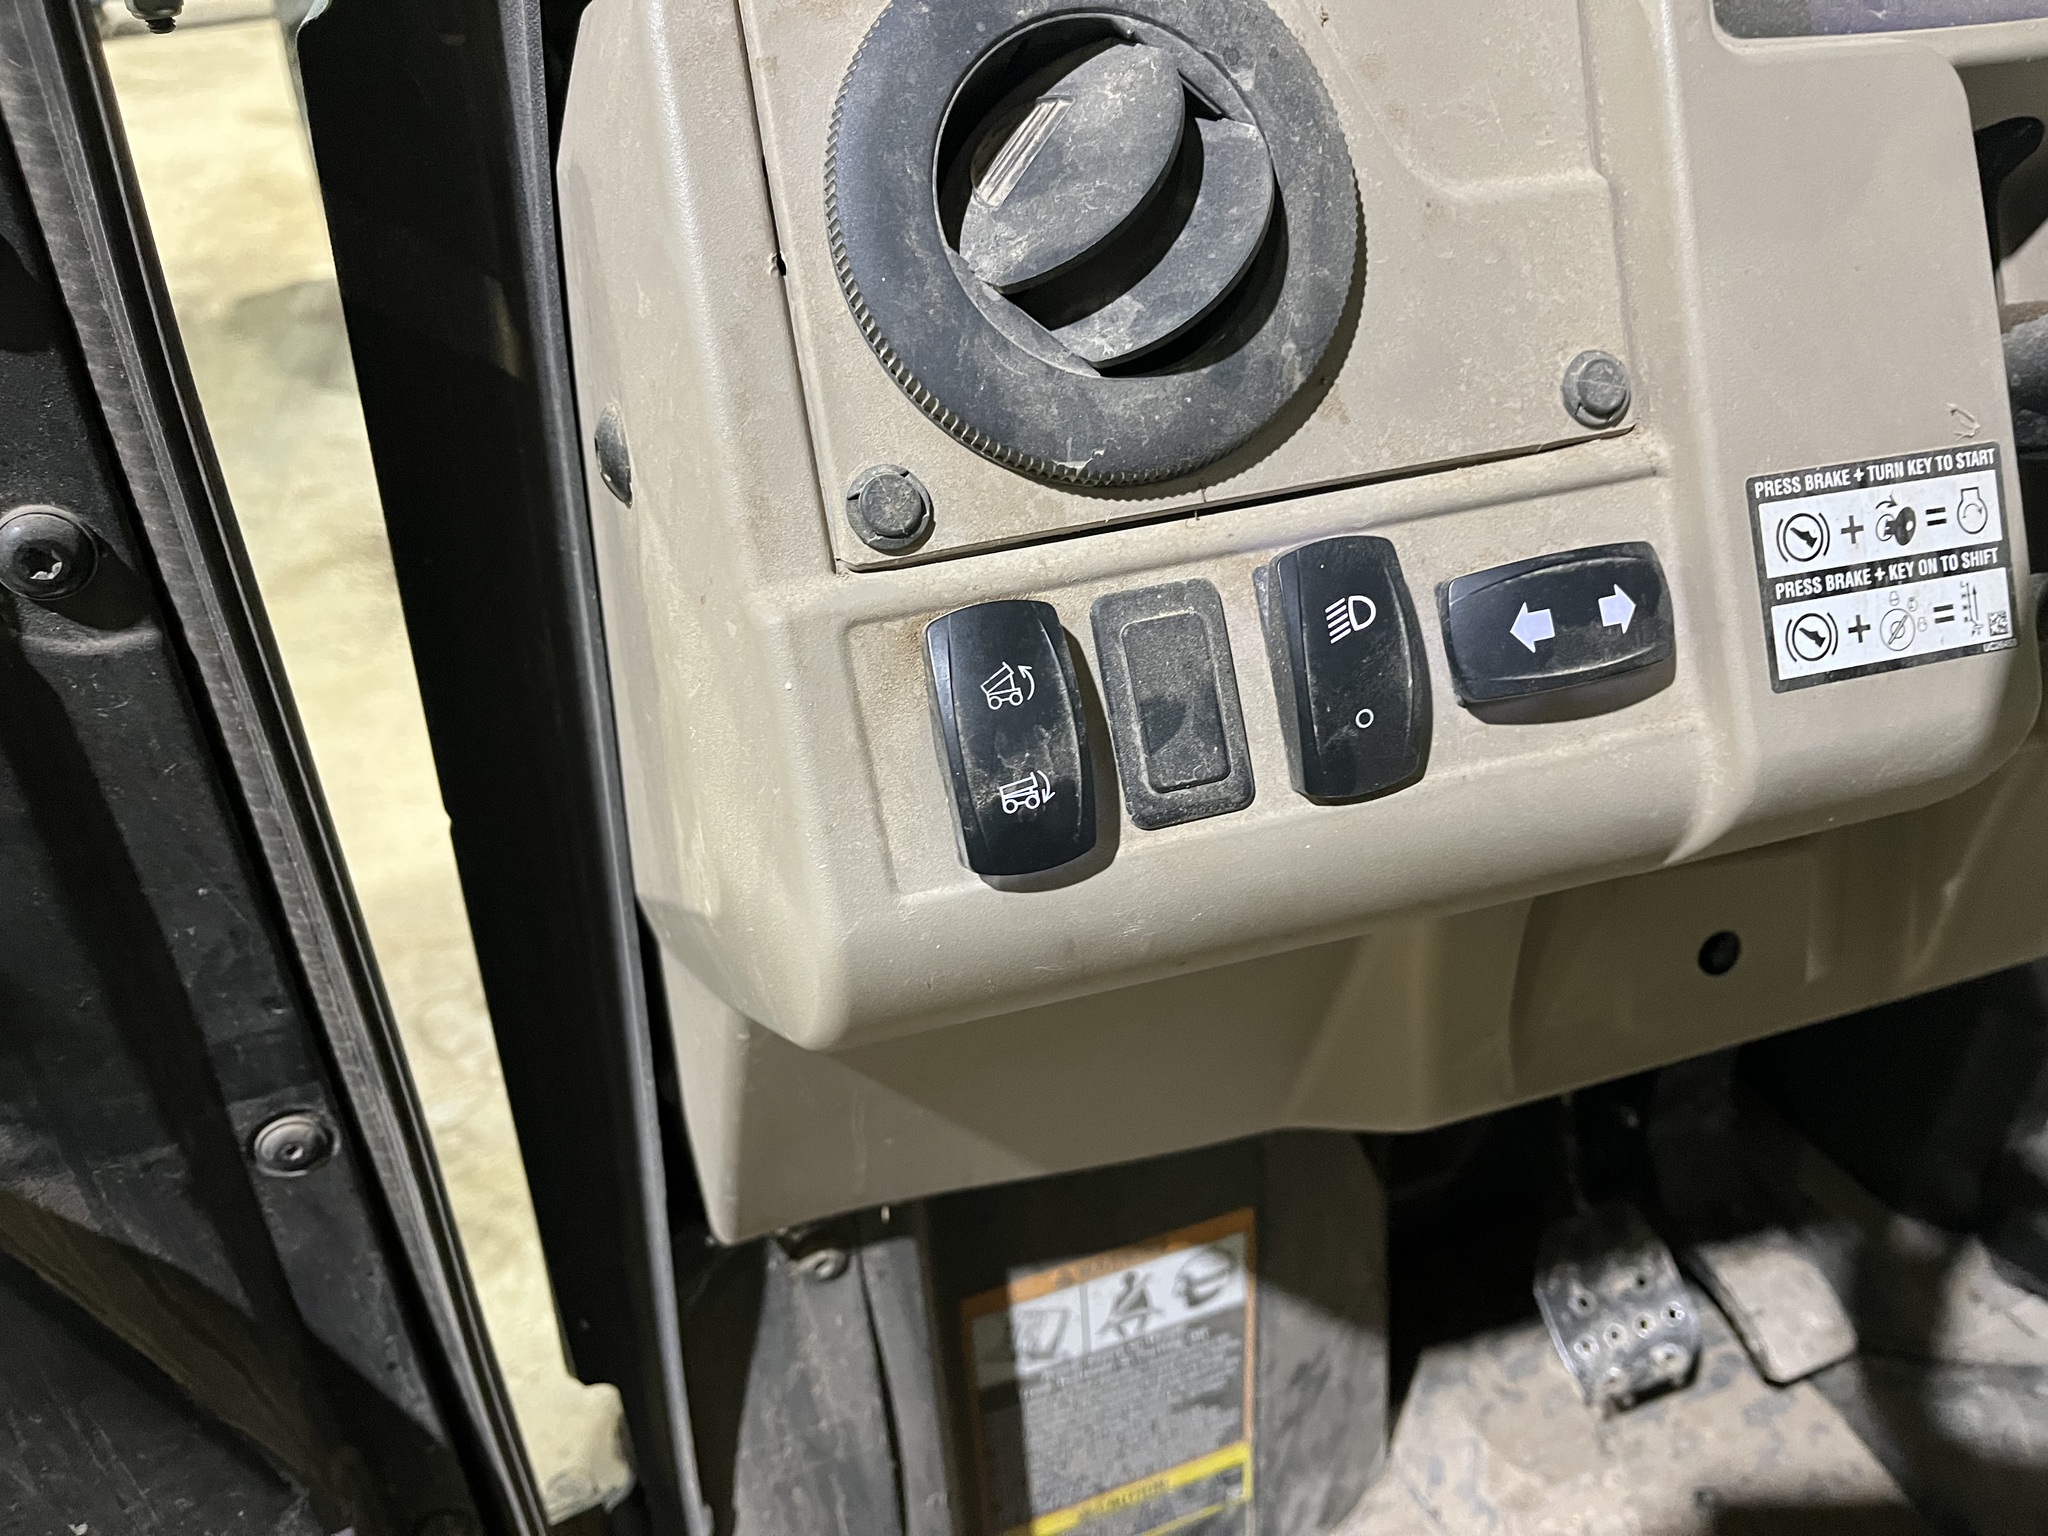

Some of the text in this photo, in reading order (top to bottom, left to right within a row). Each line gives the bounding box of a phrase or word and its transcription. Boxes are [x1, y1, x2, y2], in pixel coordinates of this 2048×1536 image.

[1755, 475, 1801, 498] PRESS
[1805, 469, 1850, 490] BRAKE
[1867, 462, 1903, 482] TURN
[1907, 457, 1931, 476] KEY
[1936, 454, 1952, 471] TO
[1955, 449, 1995, 469] START
[1775, 579, 1821, 600] PRESS
[1826, 568, 1870, 589] BRAKE
[1889, 561, 1913, 581] KEY
[1919, 557, 1938, 575] ON
[1940, 554, 1958, 572] TO
[1962, 548, 1998, 568] SHIFT
